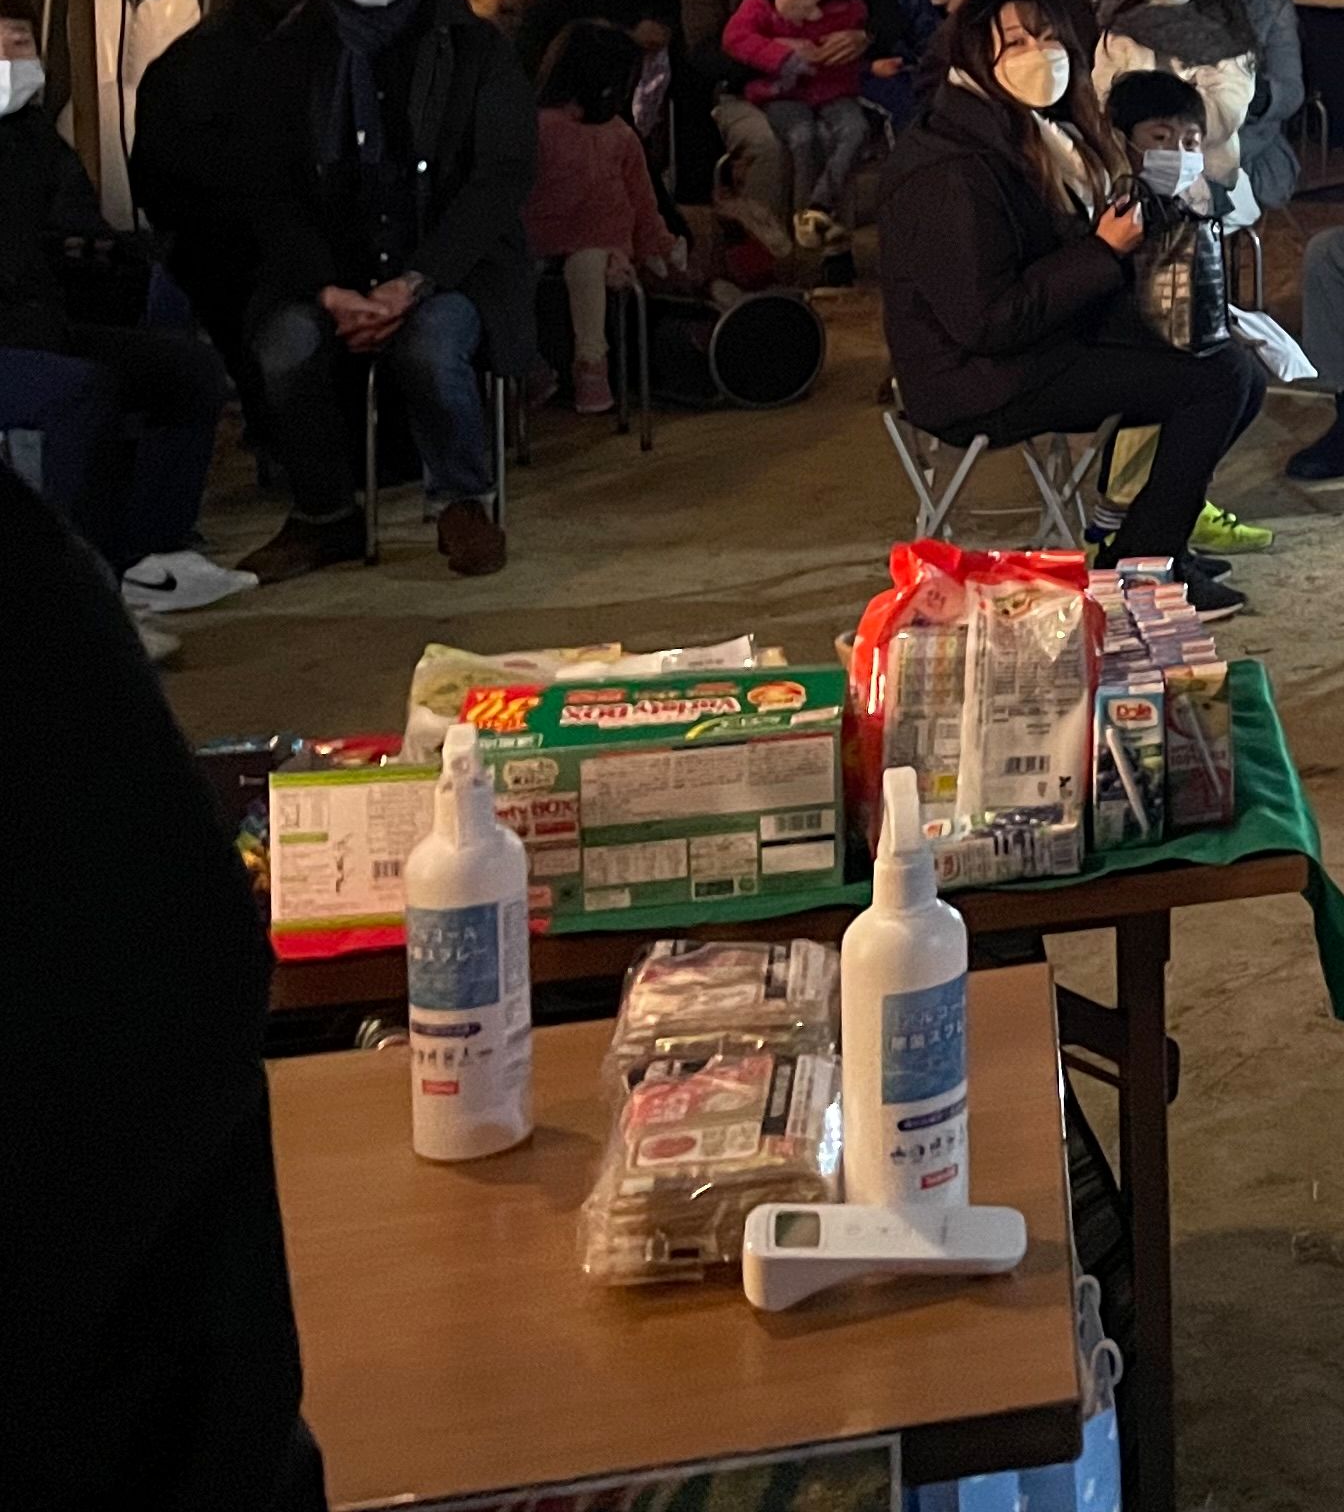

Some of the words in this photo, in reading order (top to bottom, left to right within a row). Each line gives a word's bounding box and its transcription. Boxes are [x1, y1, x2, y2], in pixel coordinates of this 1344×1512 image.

[563, 704, 628, 722] BOX
[633, 698, 736, 719] Variety
[1116, 703, 1152, 721] Dole
